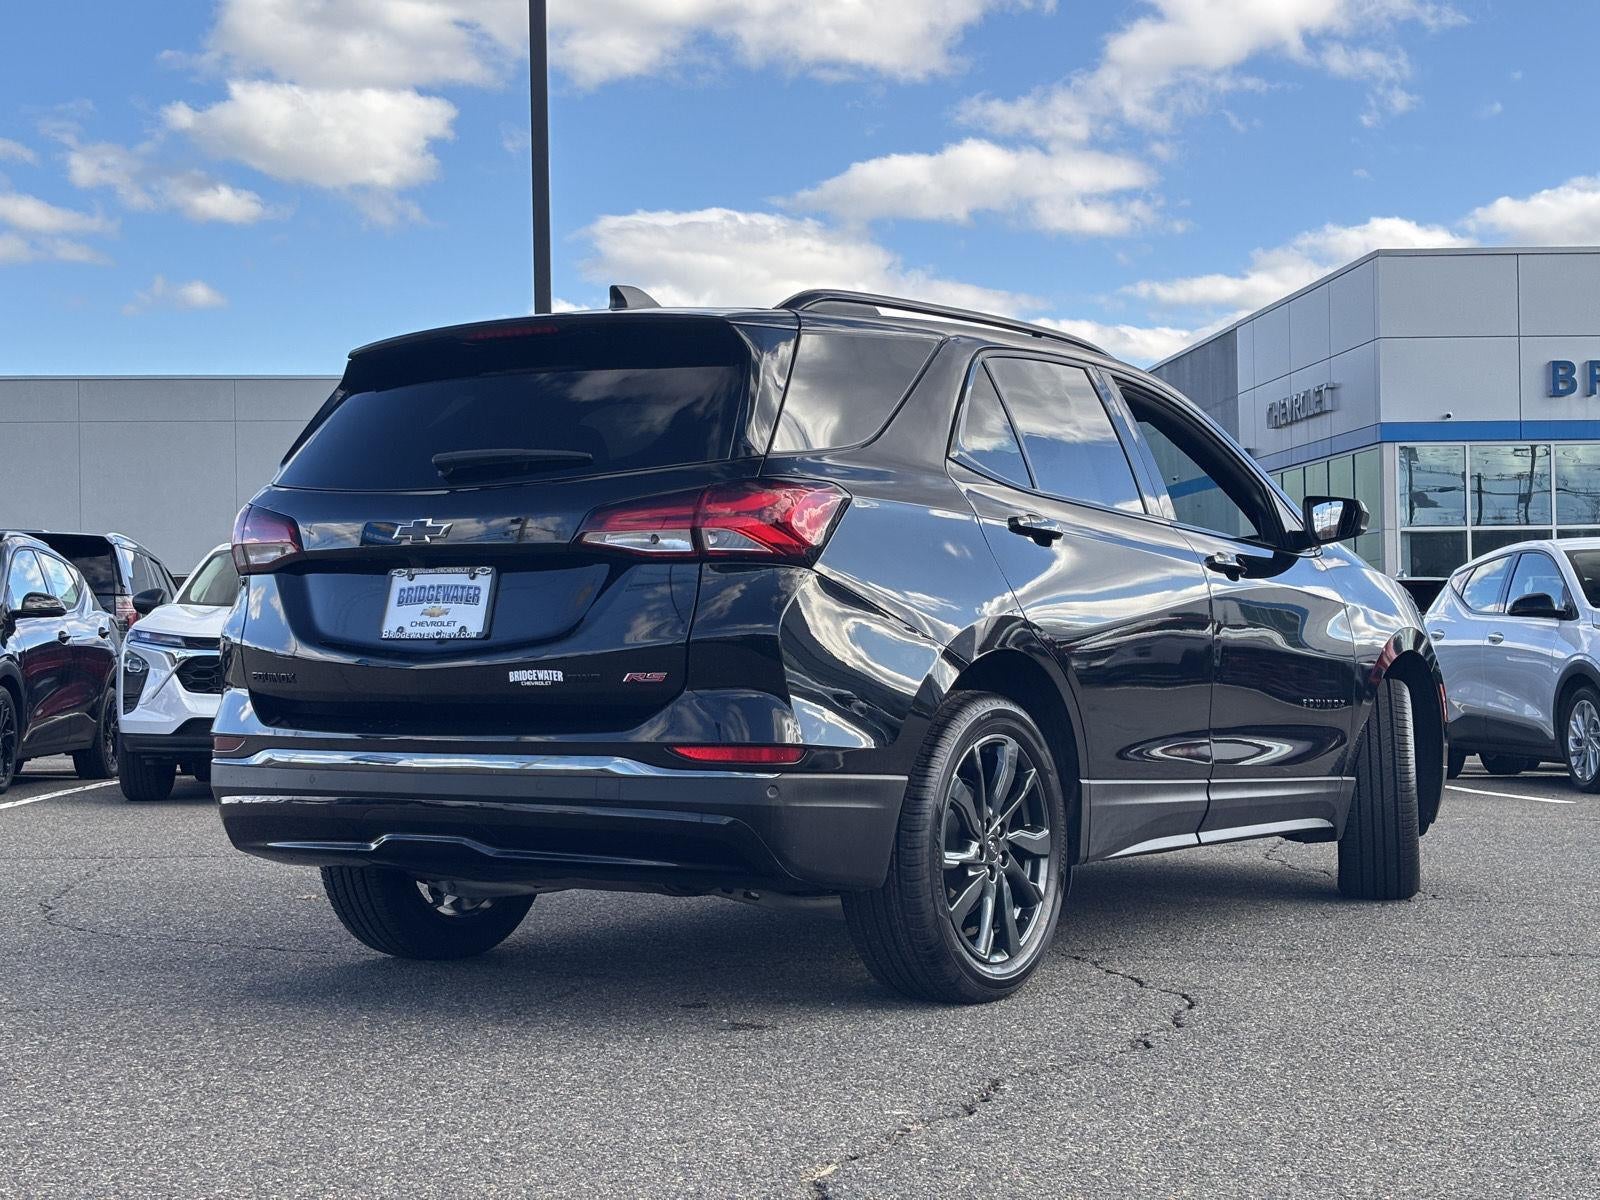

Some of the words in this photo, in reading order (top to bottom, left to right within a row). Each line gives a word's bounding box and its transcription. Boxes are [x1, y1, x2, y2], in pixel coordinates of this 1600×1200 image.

[1266, 383, 1338, 429] CHEVROLET
[397, 584, 481, 607] BRIDGEWATER
[410, 620, 458, 628] CHEVROLET
[508, 669, 563, 682] BRIDGEWATER
[623, 672, 667, 682] RS
[1303, 698, 1346, 708] EQUINOX
